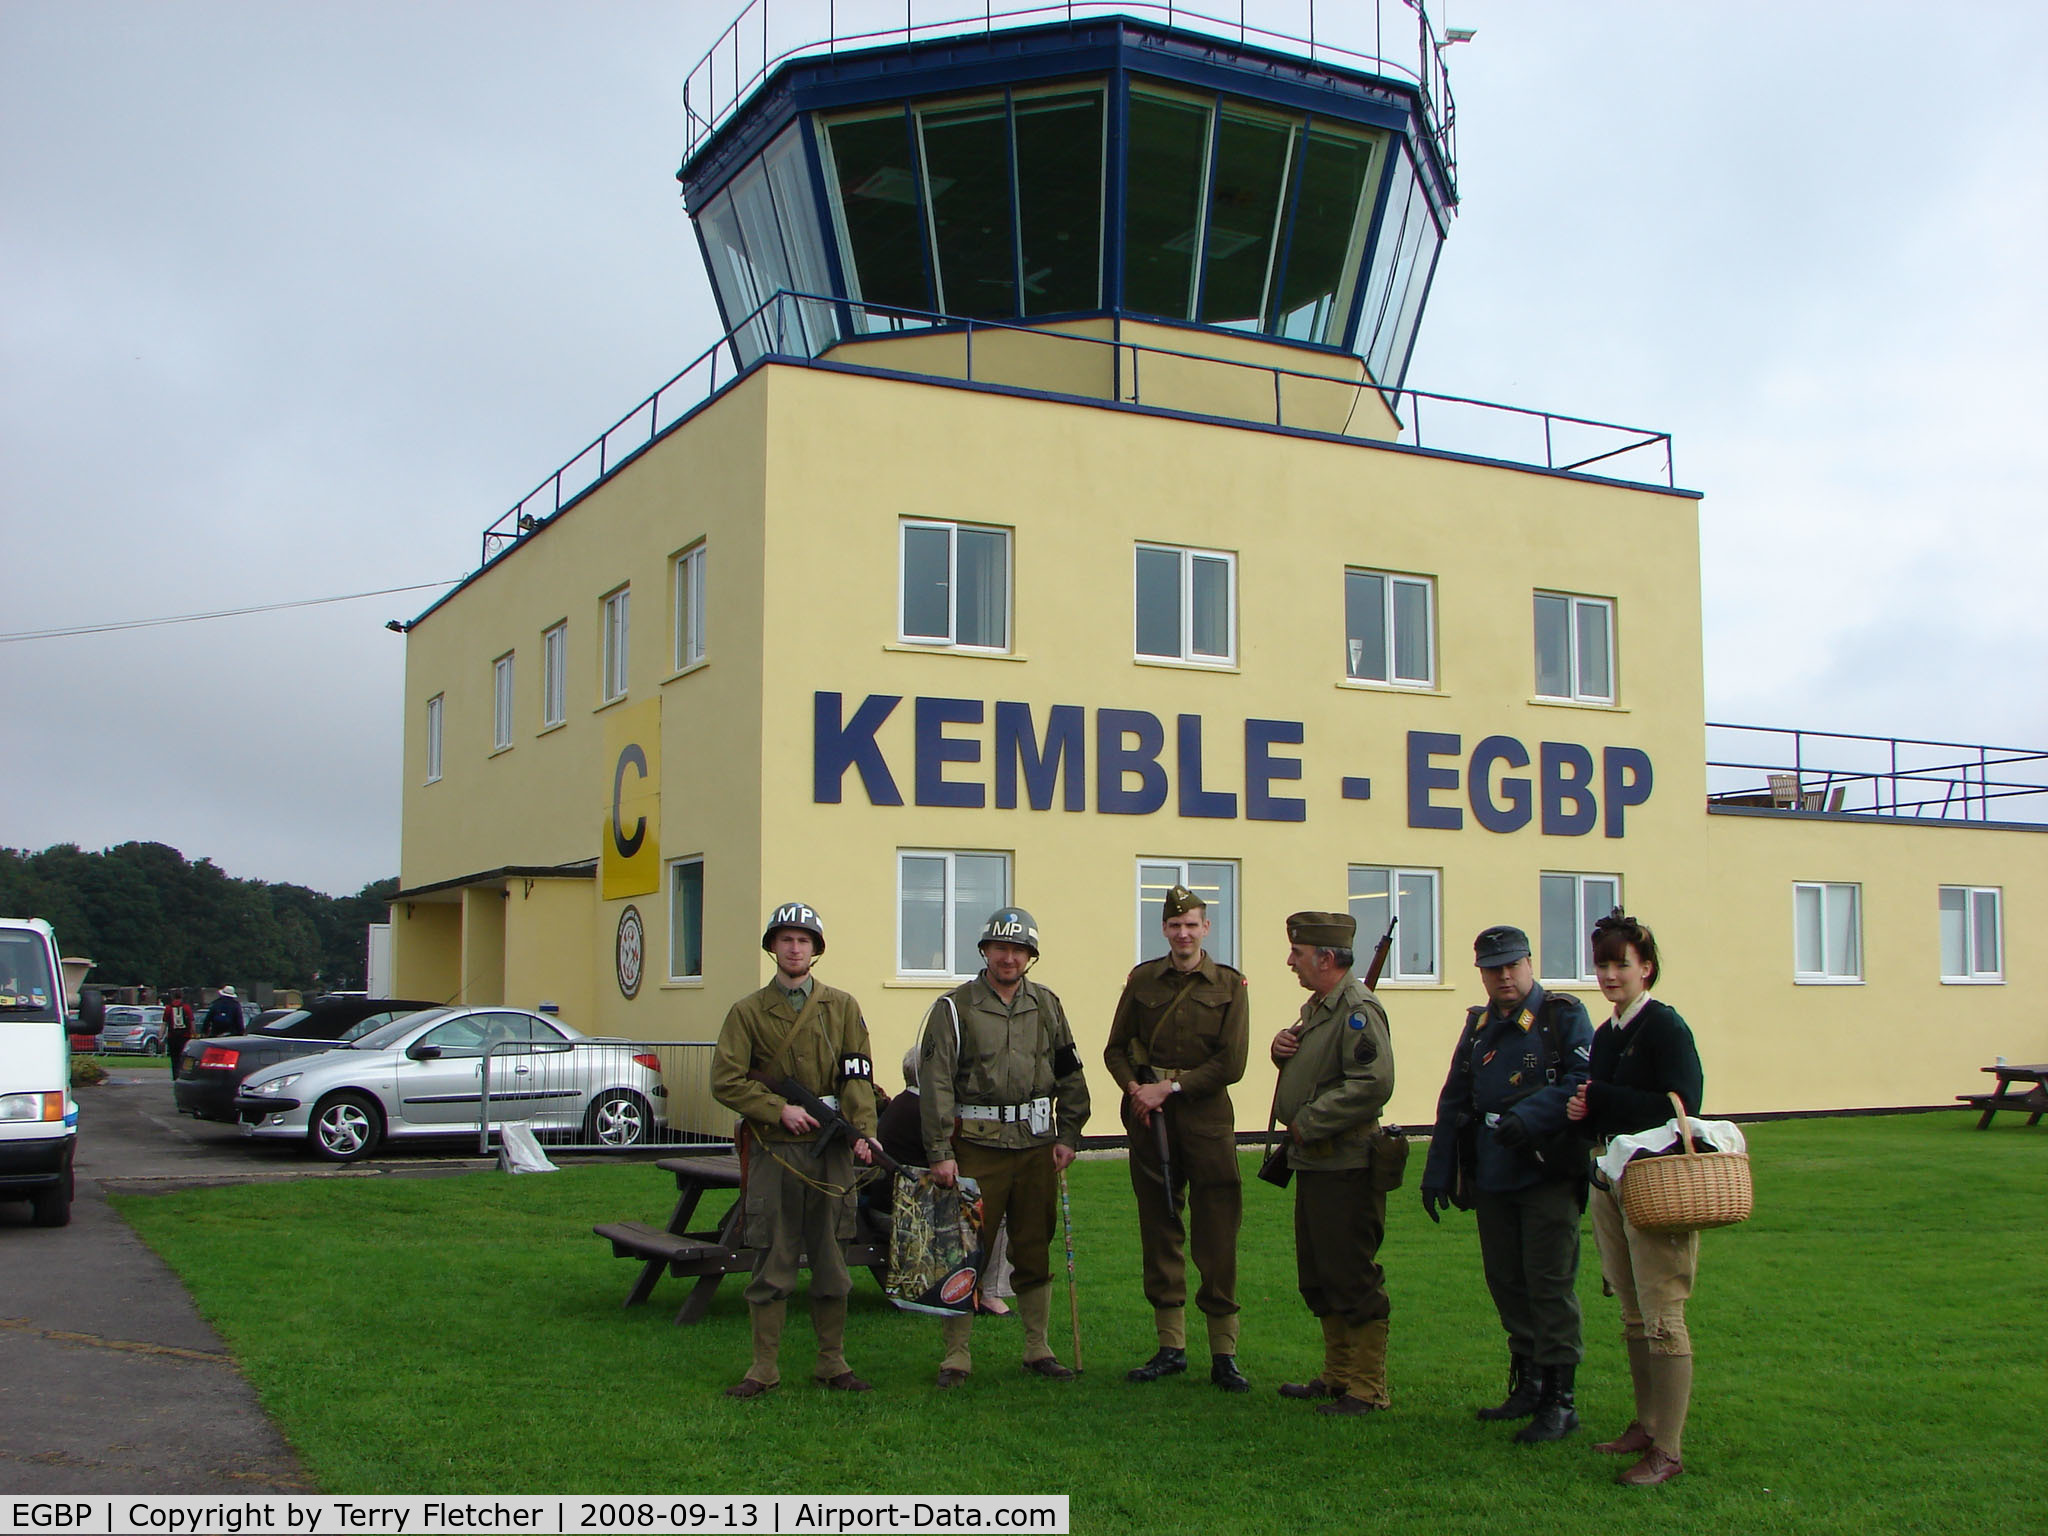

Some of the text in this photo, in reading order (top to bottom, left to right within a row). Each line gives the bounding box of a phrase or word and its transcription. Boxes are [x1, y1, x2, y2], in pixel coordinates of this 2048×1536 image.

[815, 691, 1306, 822] KEMBLE
[1408, 731, 1654, 838] EGBP
[613, 743, 648, 858] C
[778, 906, 814, 923] MP
[992, 921, 1022, 936] MP
[844, 1058, 871, 1076] MP
